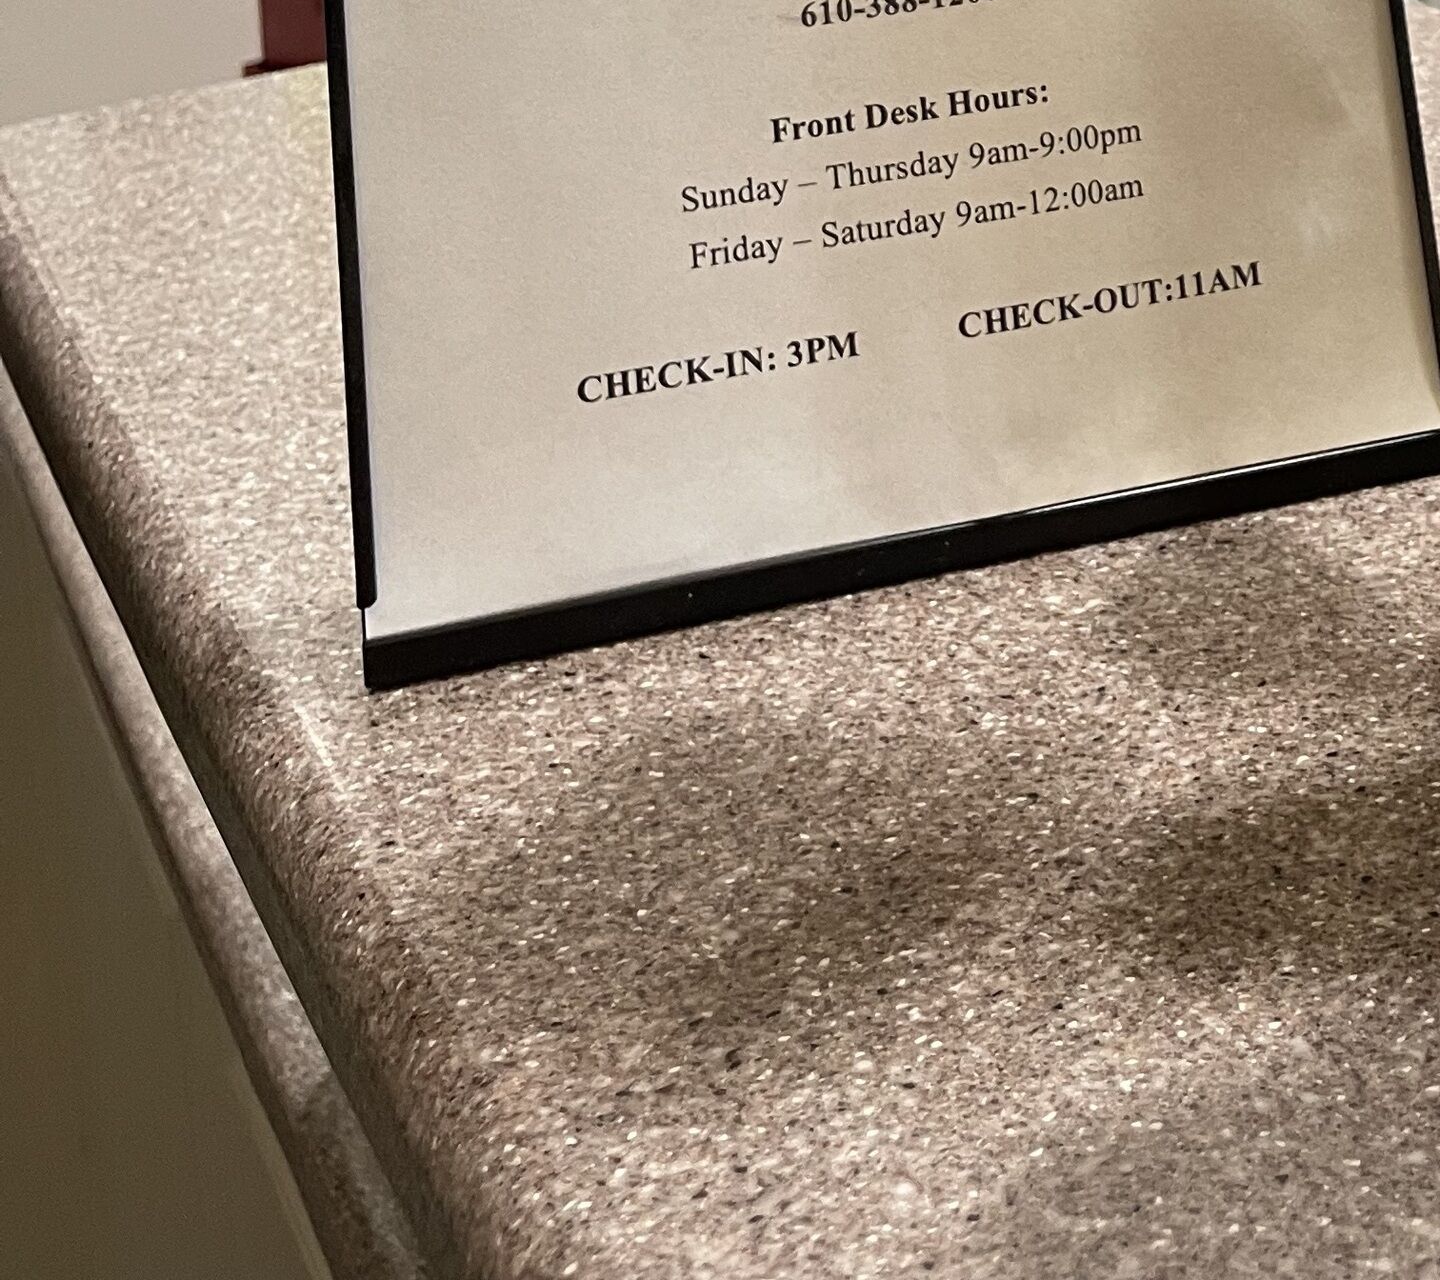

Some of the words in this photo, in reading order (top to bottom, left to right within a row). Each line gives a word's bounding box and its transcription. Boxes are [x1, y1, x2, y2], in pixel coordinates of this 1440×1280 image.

[770, 110, 856, 144] Front
[864, 97, 939, 131] Desk
[947, 81, 1049, 117] Hours:
[680, 175, 789, 214] Sunday
[825, 148, 959, 193] Thursday
[968, 122, 1142, 169] 9am-9:00pm
[689, 233, 784, 270] Friday
[821, 204, 946, 251] Saturday
[955, 175, 1144, 229] 9am-12:00am
[957, 262, 1264, 339] CHECK-OUT:11AM
[577, 346, 777, 405] CHECK-IN:
[786, 331, 861, 369] 3PM
